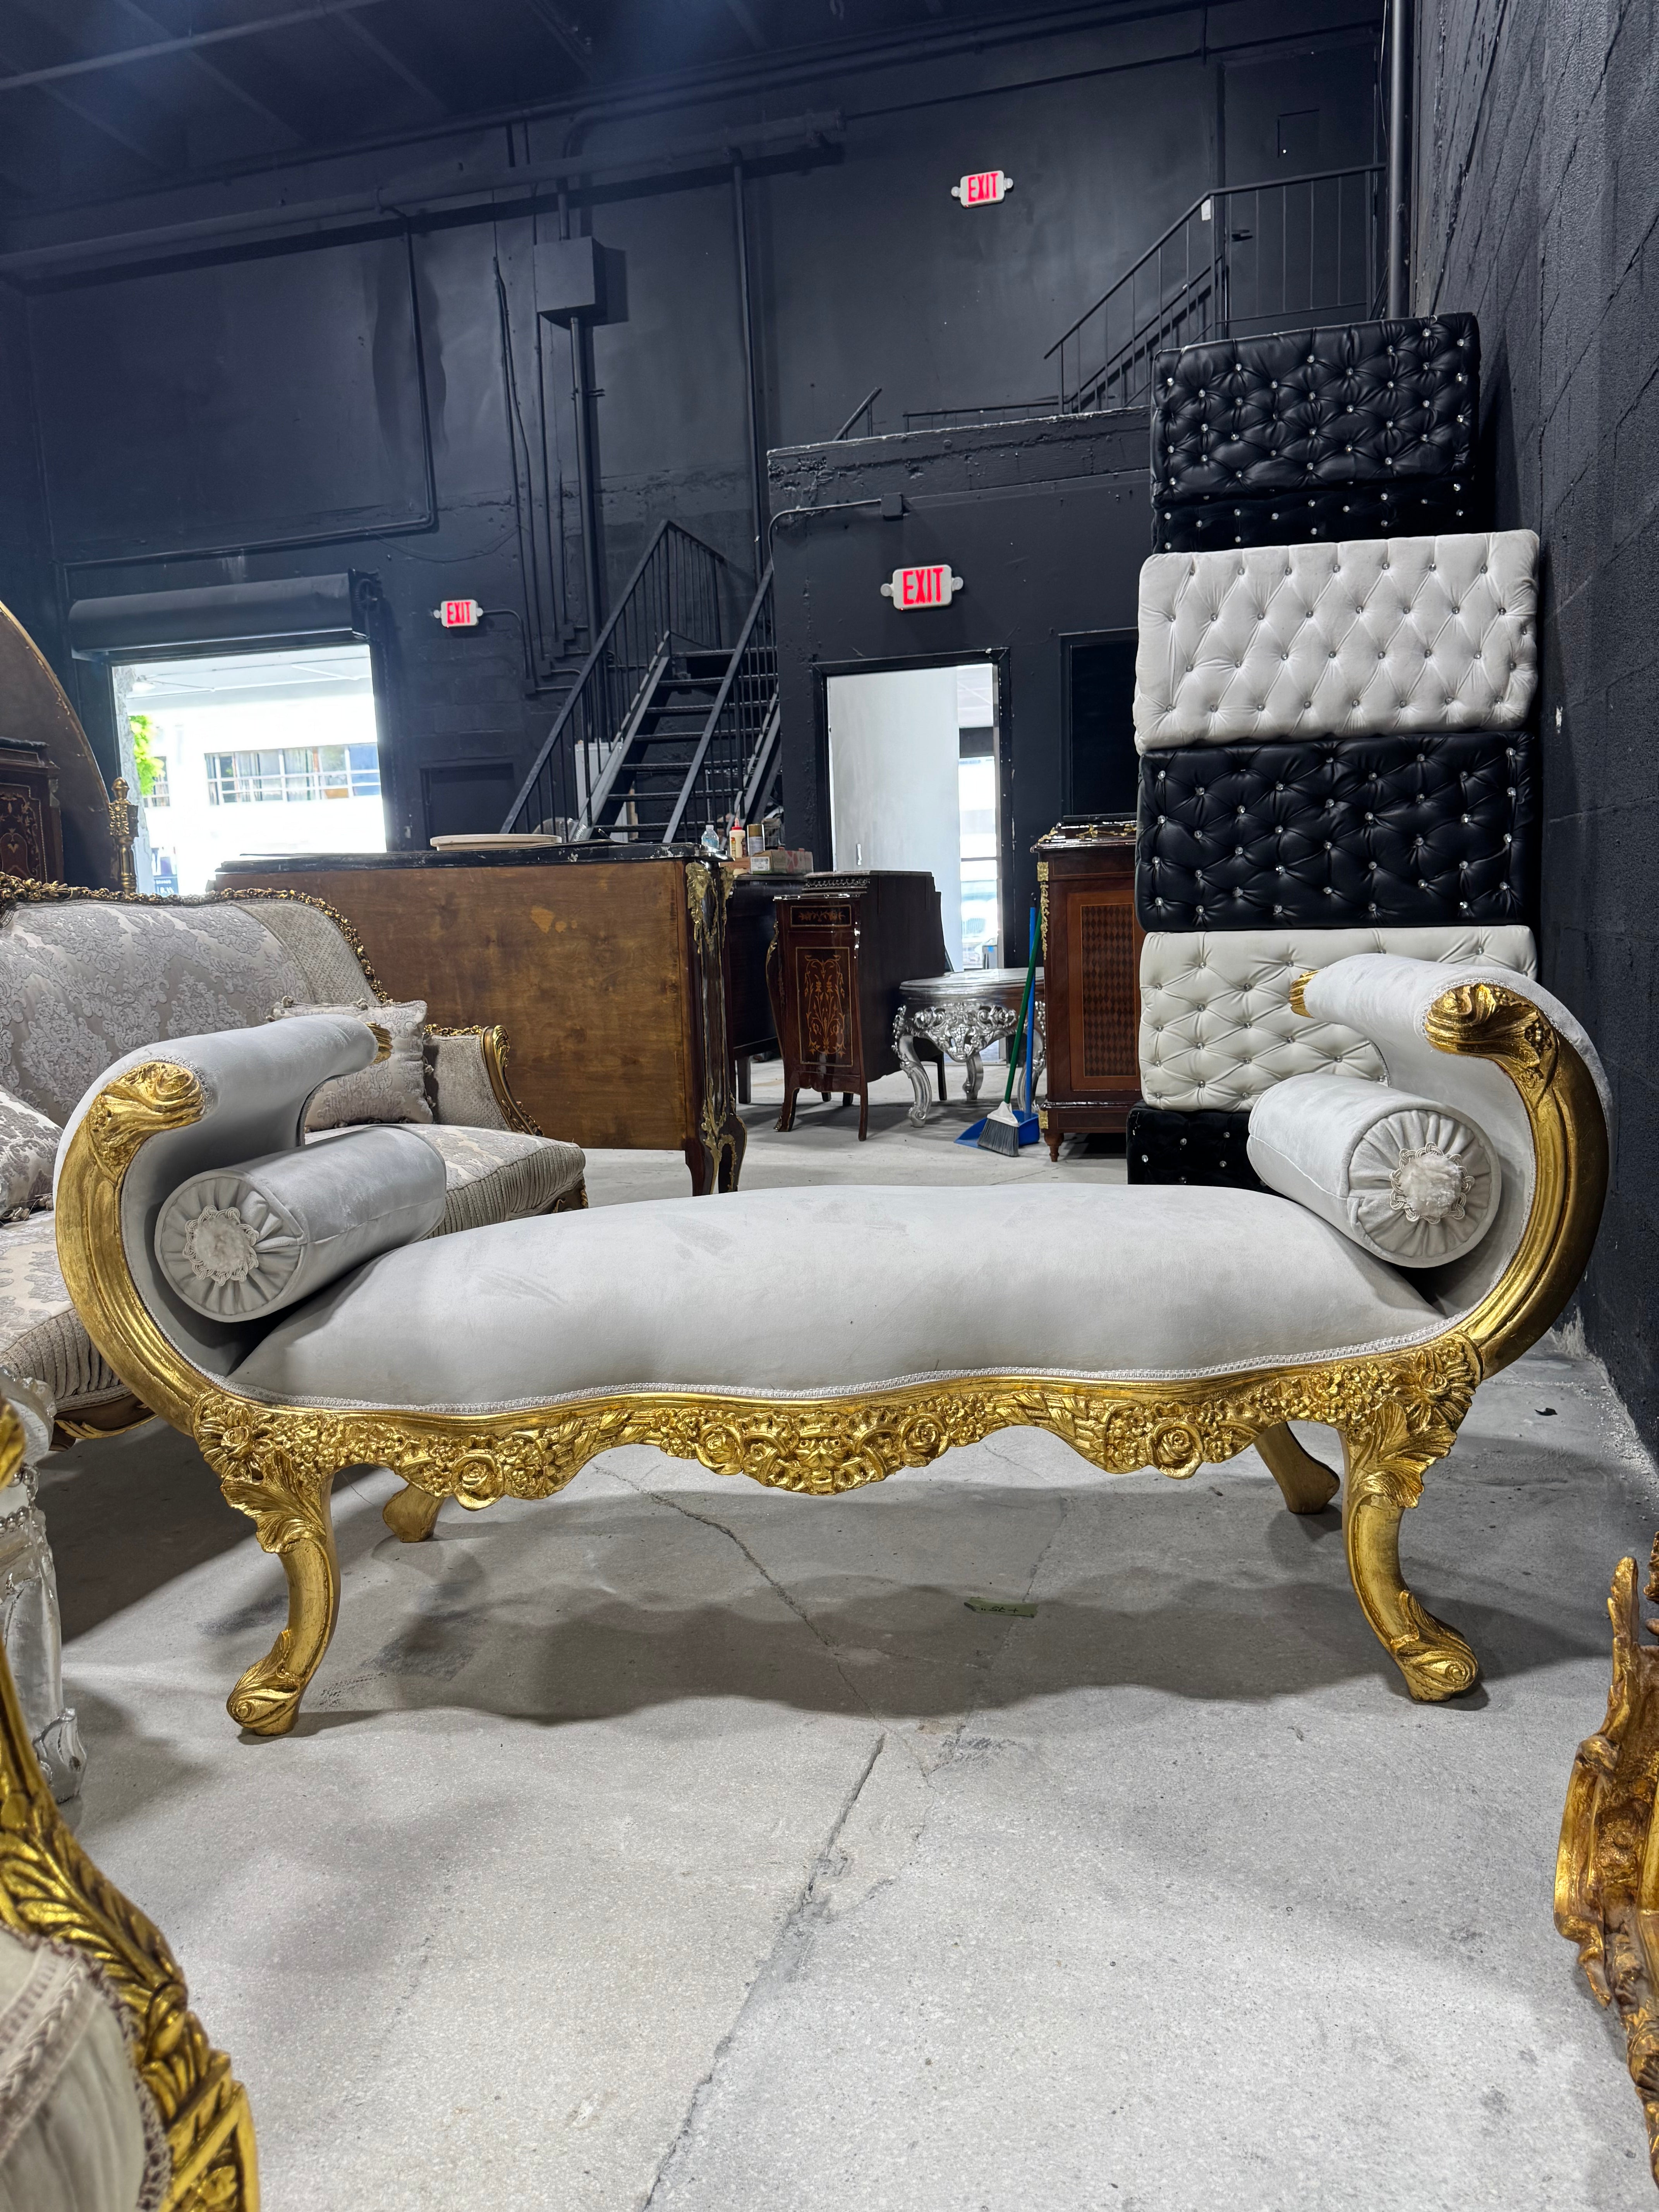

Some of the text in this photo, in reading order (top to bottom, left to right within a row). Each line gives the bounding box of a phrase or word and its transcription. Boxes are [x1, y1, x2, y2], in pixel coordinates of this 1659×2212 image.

[968, 173, 998, 202] EXIT
[903, 567, 943, 605] EXIT
[447, 601, 471, 625] EXIT
